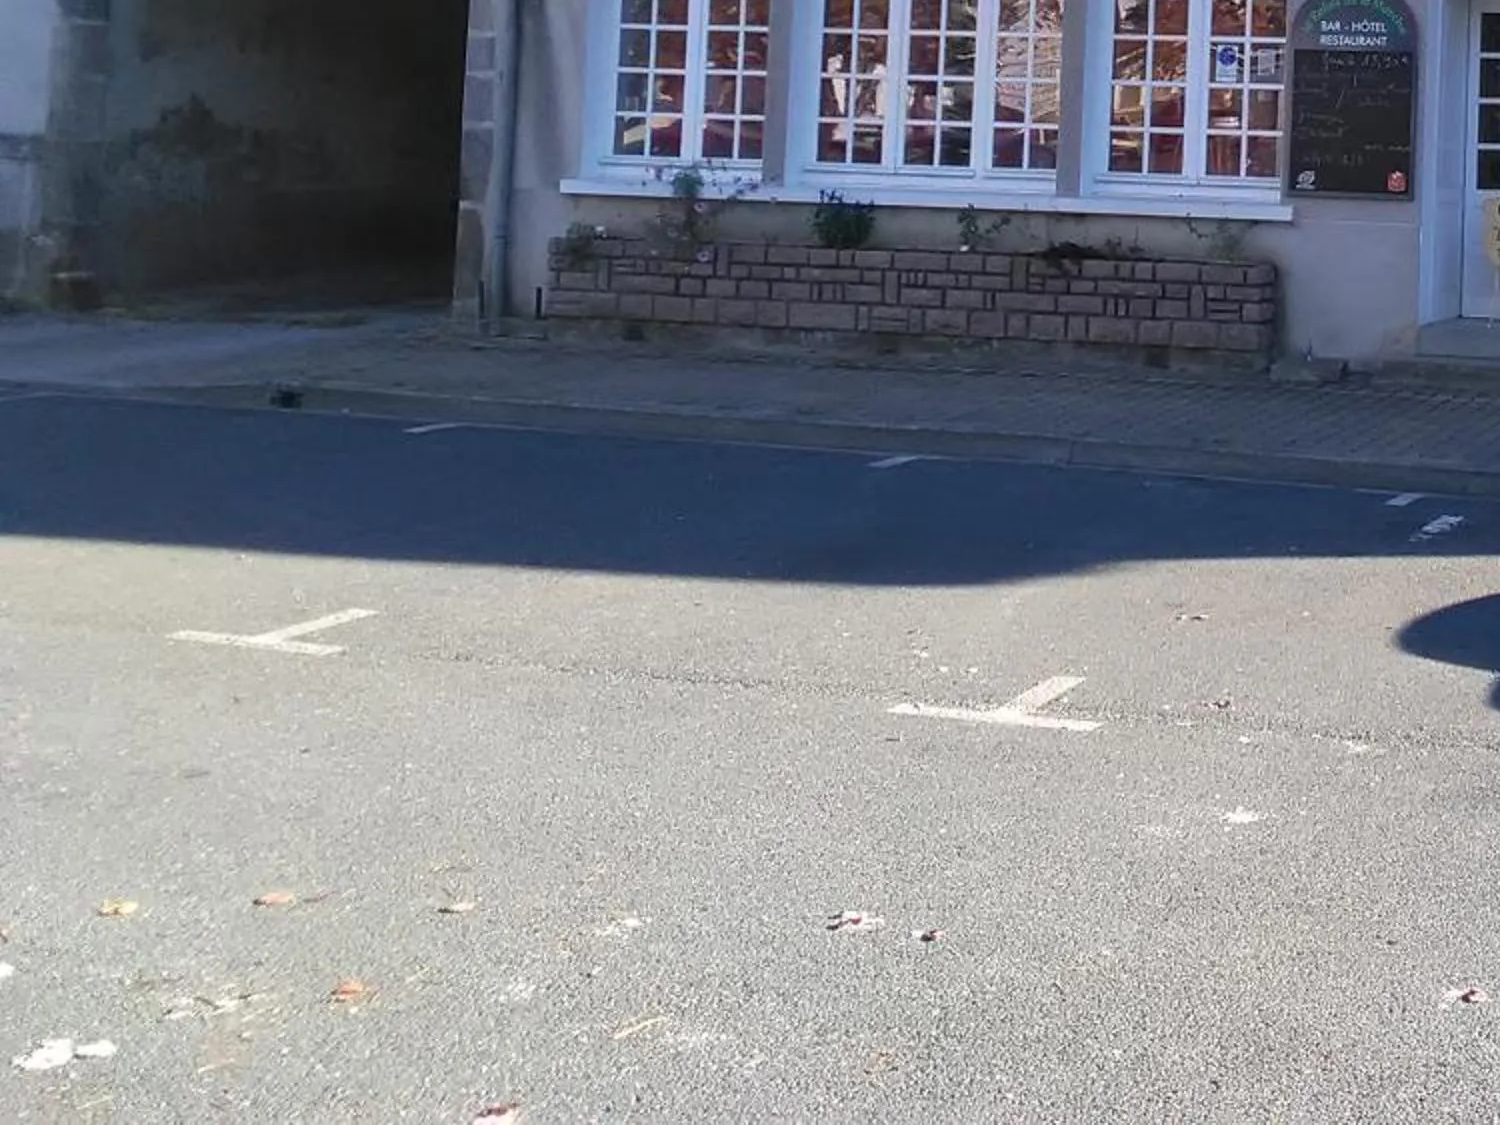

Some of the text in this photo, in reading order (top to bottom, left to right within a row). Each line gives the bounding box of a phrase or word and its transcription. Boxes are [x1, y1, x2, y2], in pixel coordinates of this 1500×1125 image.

[1321, 21, 1341, 32] BAR
[1351, 19, 1387, 33] HÔTEL
[1320, 35, 1387, 46] RESTAURANT
